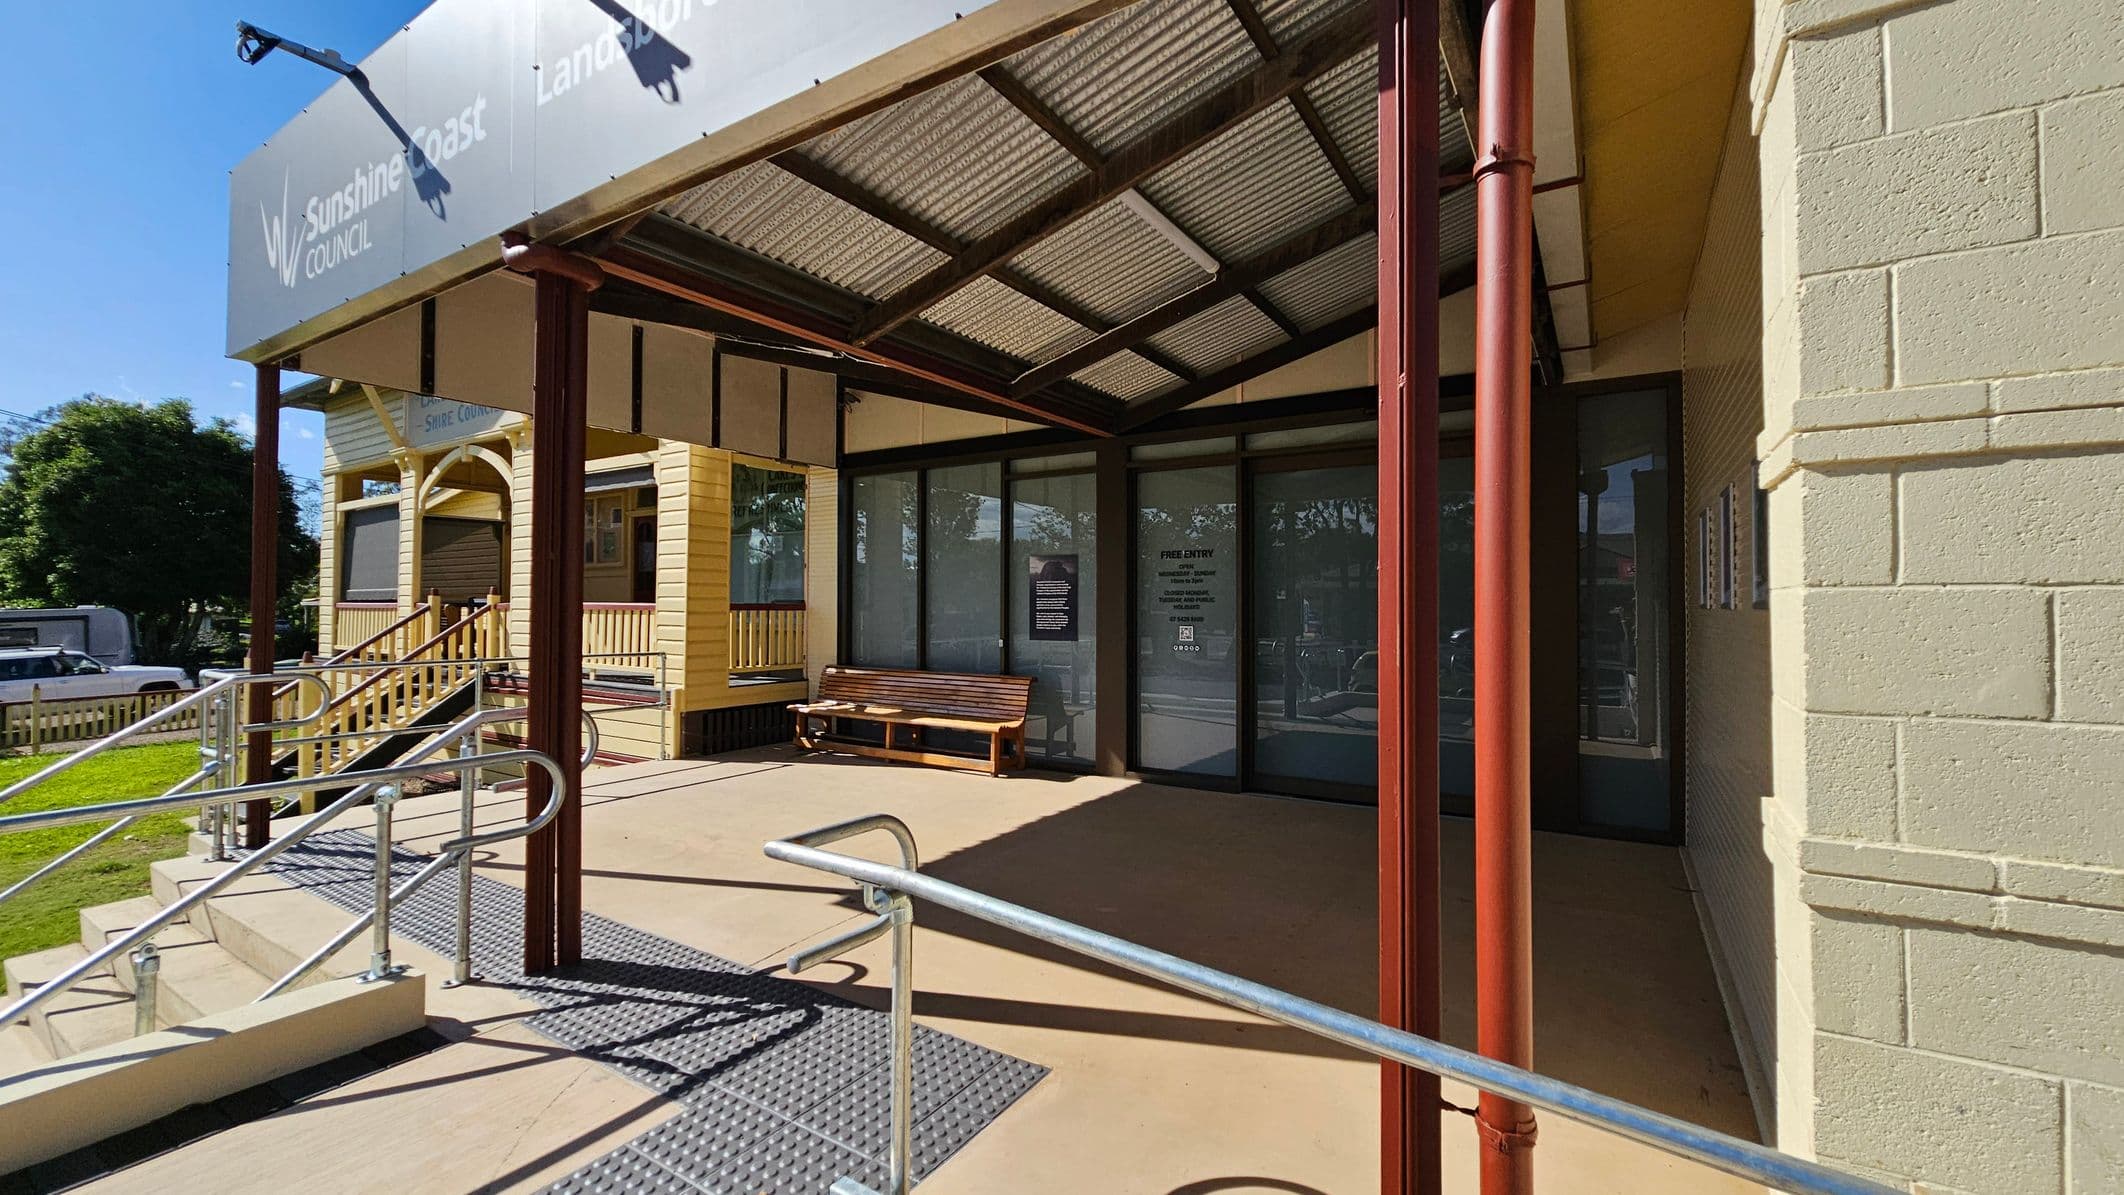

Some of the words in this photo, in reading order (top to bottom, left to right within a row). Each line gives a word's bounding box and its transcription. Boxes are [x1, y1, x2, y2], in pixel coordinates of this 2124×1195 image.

[536, 0, 718, 107] Landsbor
[305, 149, 404, 242] Sunshine
[406, 93, 488, 178] Coast
[305, 219, 372, 280] COUNCIL
[425, 410, 454, 433] SHIRE
[1160, 550, 1182, 559] FREE
[1184, 549, 1214, 559] ENTRY
